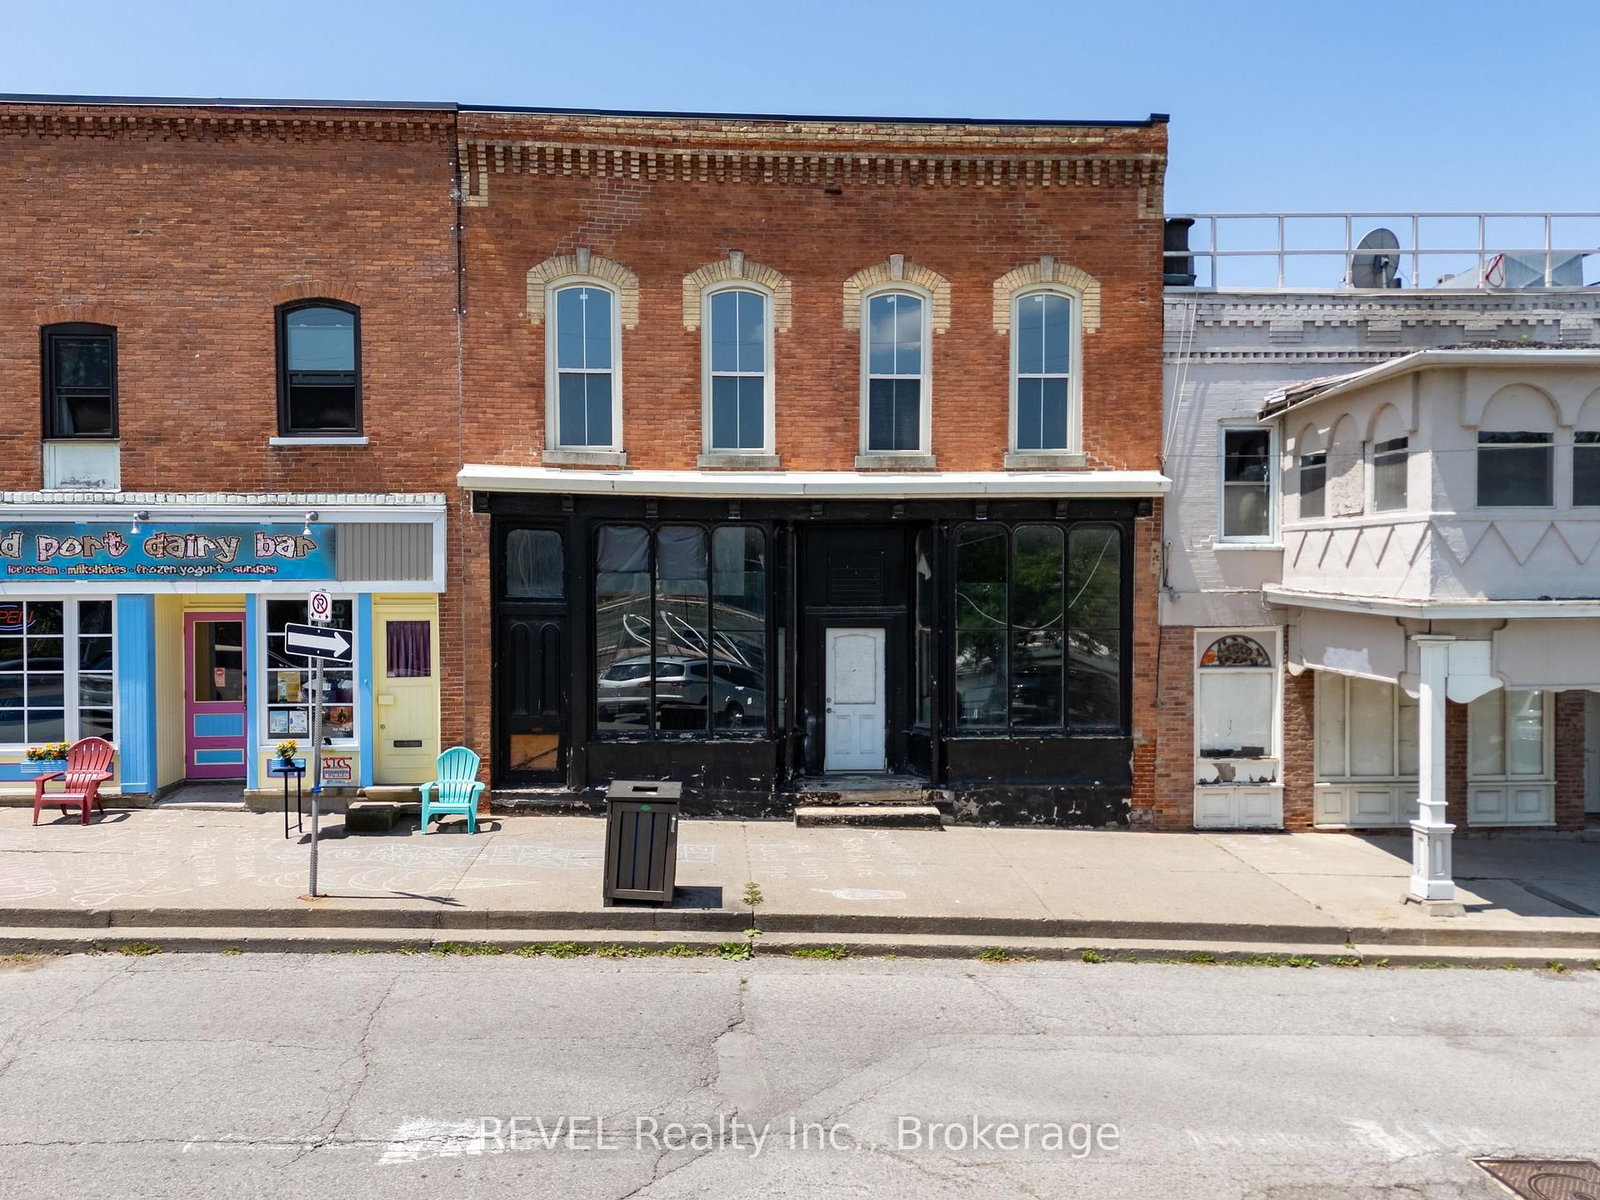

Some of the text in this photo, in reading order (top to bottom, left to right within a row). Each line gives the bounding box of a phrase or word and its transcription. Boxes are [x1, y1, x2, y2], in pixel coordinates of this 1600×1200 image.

[0, 530, 317, 563] d port dairy bar
[7, 564, 278, 577] ice cream milkshakes frozen yogurt sundaes
